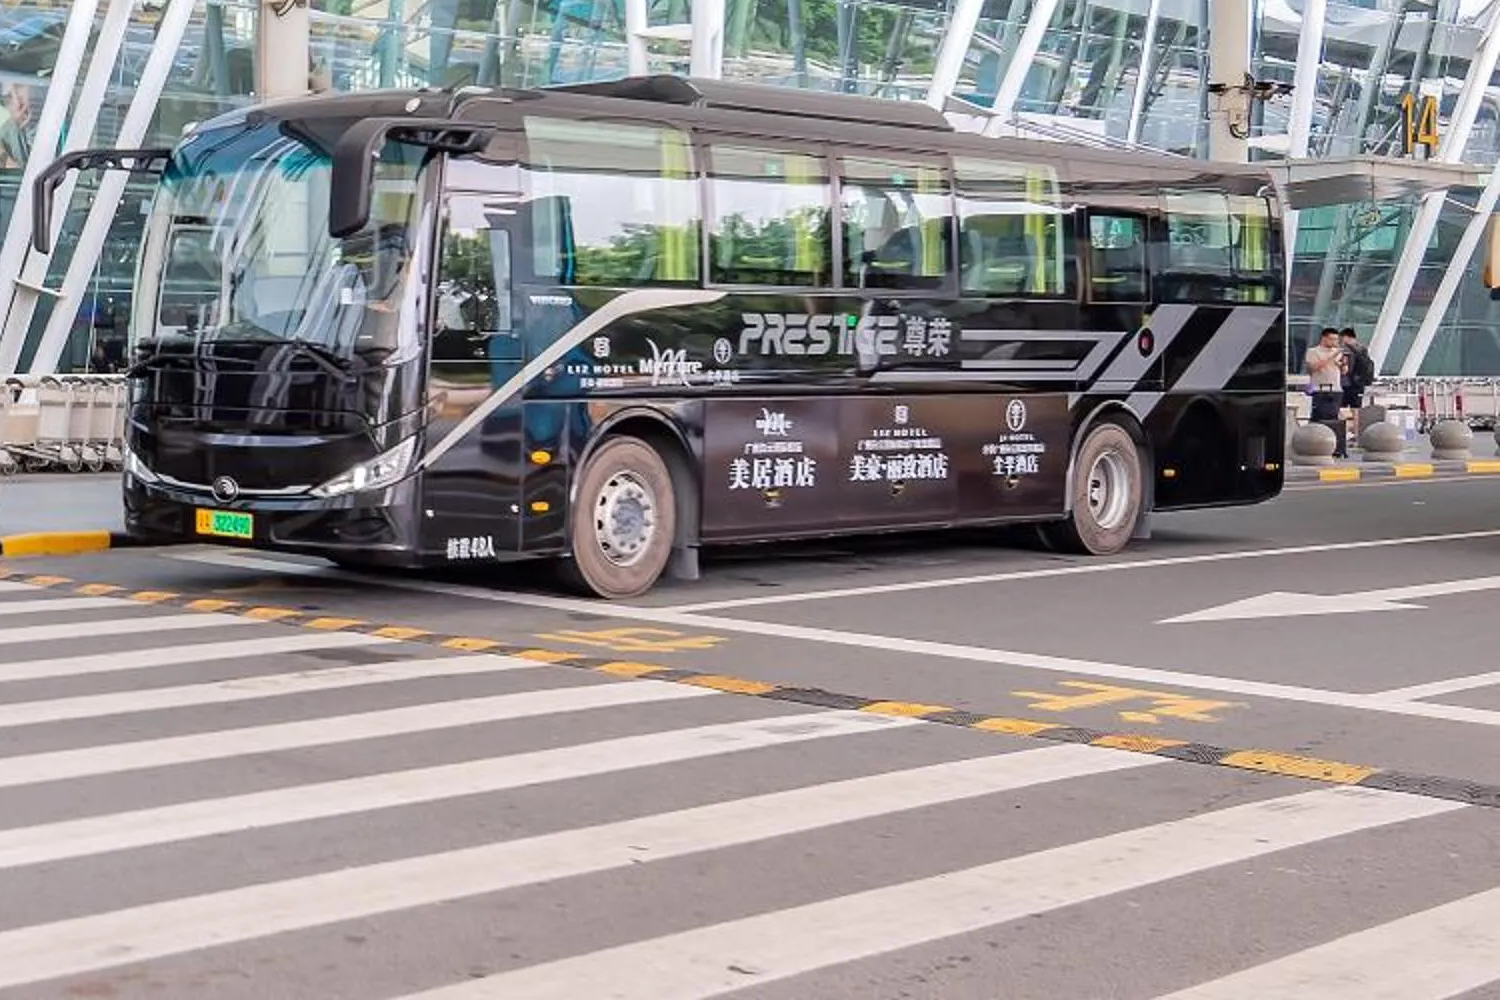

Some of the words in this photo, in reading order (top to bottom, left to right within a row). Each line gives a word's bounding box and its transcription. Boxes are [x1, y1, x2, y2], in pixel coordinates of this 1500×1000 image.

[1402, 93, 1439, 156] 14
[903, 317, 951, 357] 尊荣
[593, 364, 635, 374] HOTEL
[728, 456, 817, 489] 美居酒店
